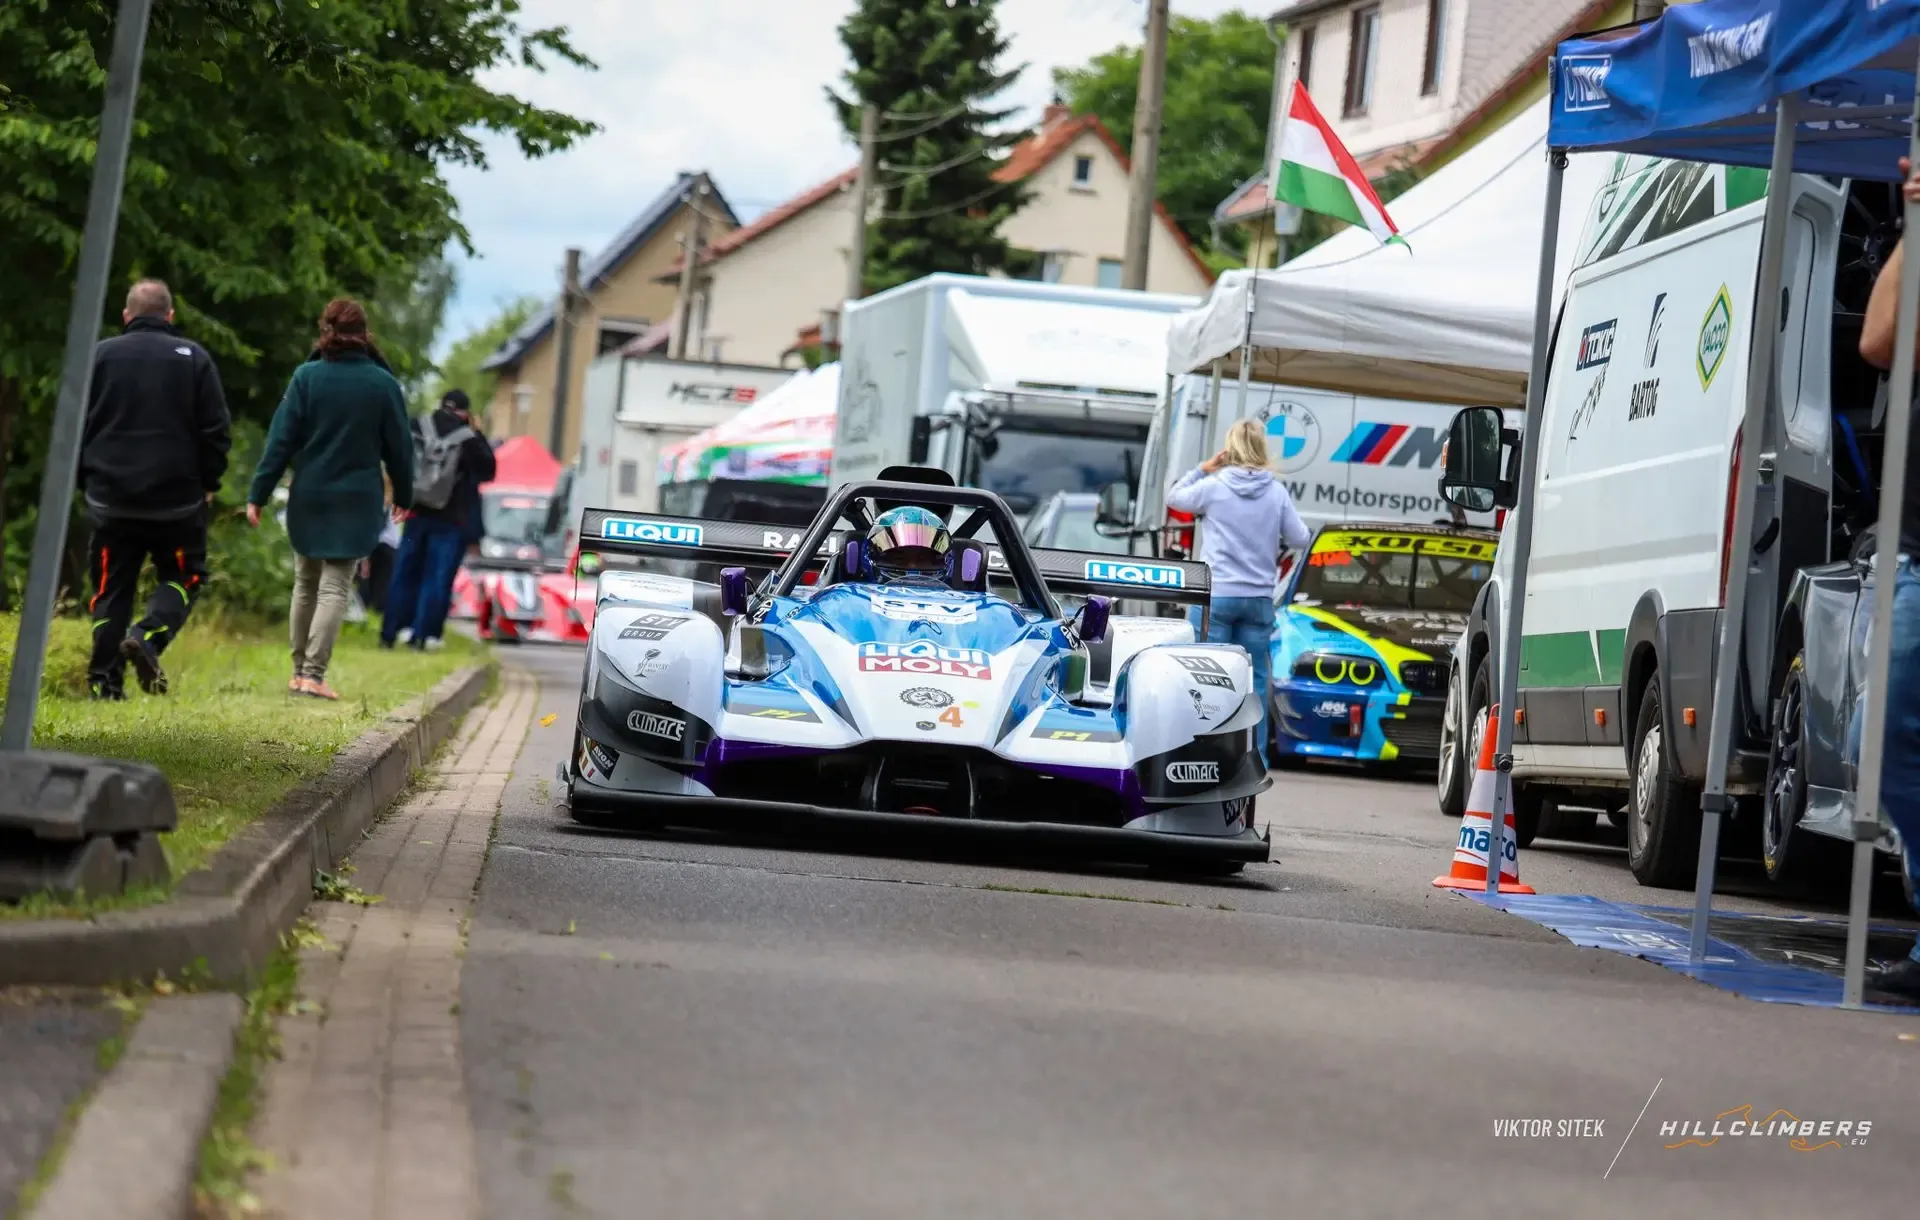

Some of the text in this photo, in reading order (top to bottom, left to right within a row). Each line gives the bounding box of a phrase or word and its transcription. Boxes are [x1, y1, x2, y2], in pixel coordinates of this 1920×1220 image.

[609, 521, 696, 543] LIQUI
[1091, 563, 1178, 585] LIQUI
[623, 630, 663, 639] GROUP
[865, 643, 984, 665] LIQUI
[866, 657, 991, 678] MOLY
[938, 706, 964, 728] 4
